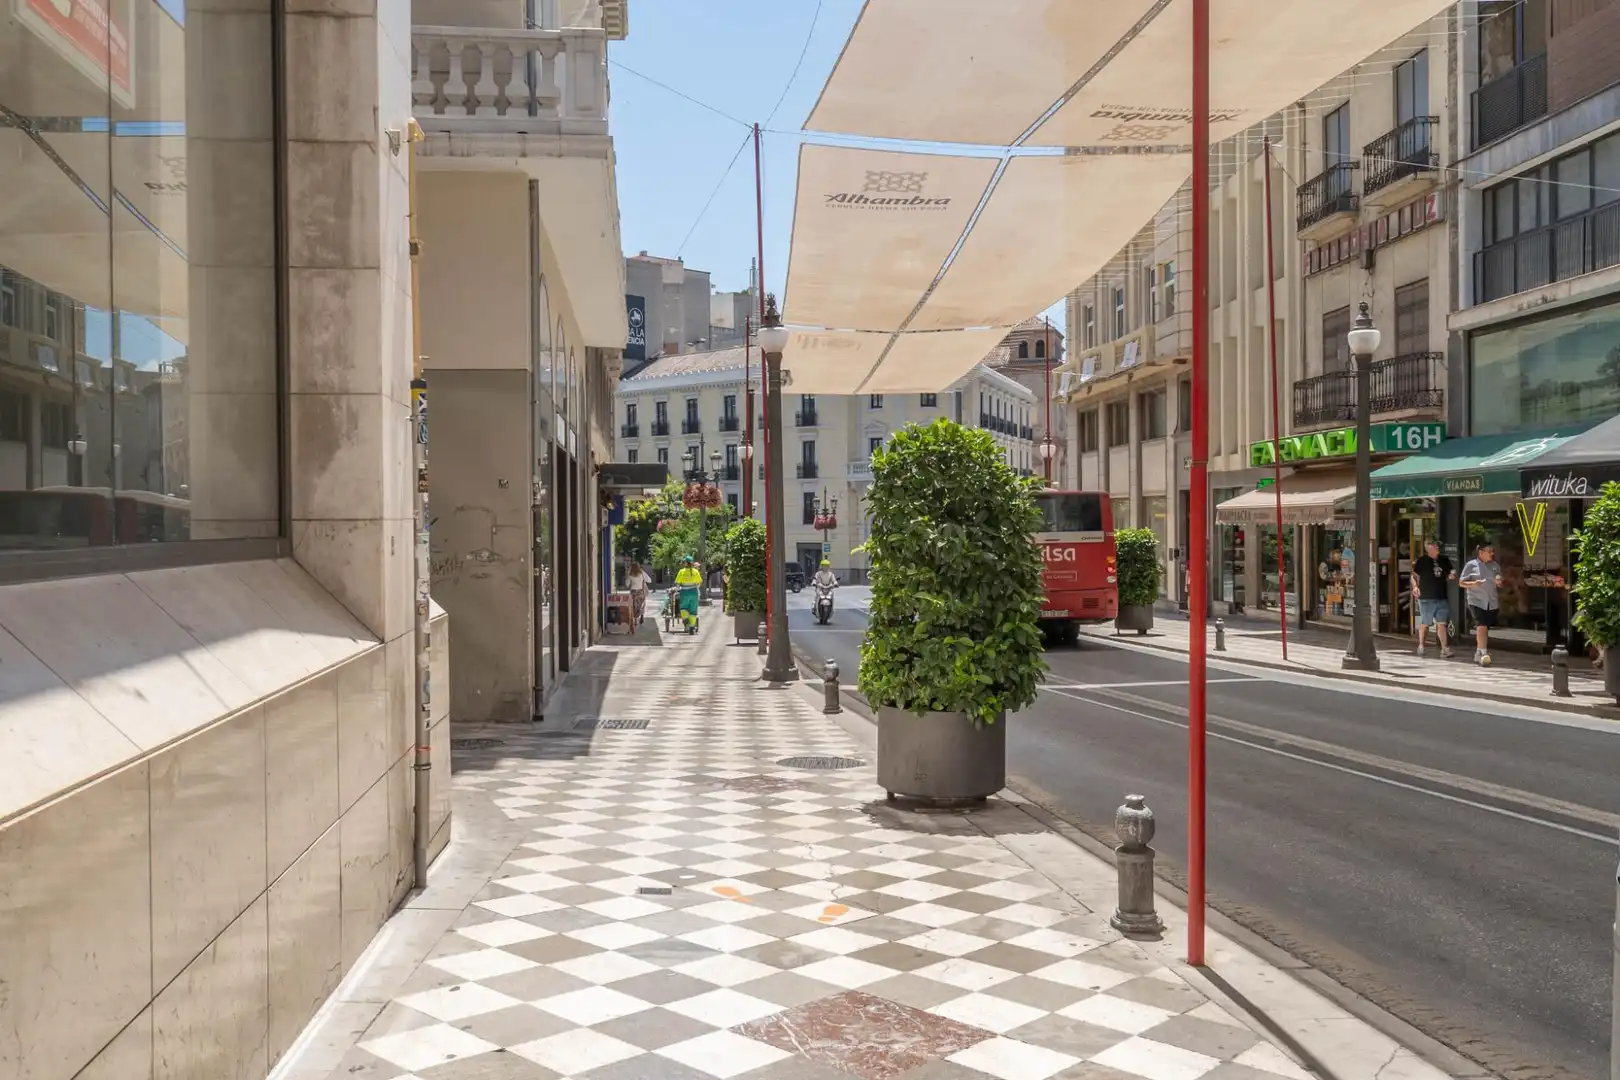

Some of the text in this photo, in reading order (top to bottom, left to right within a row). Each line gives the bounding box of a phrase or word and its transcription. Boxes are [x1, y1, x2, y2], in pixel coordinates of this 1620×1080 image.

[823, 193, 952, 206] Alhambra
[1391, 425, 1442, 449] 16H
[1446, 479, 1480, 490] VIANDAS
[1531, 470, 1588, 496] wituka
[1515, 503, 1548, 556] V
